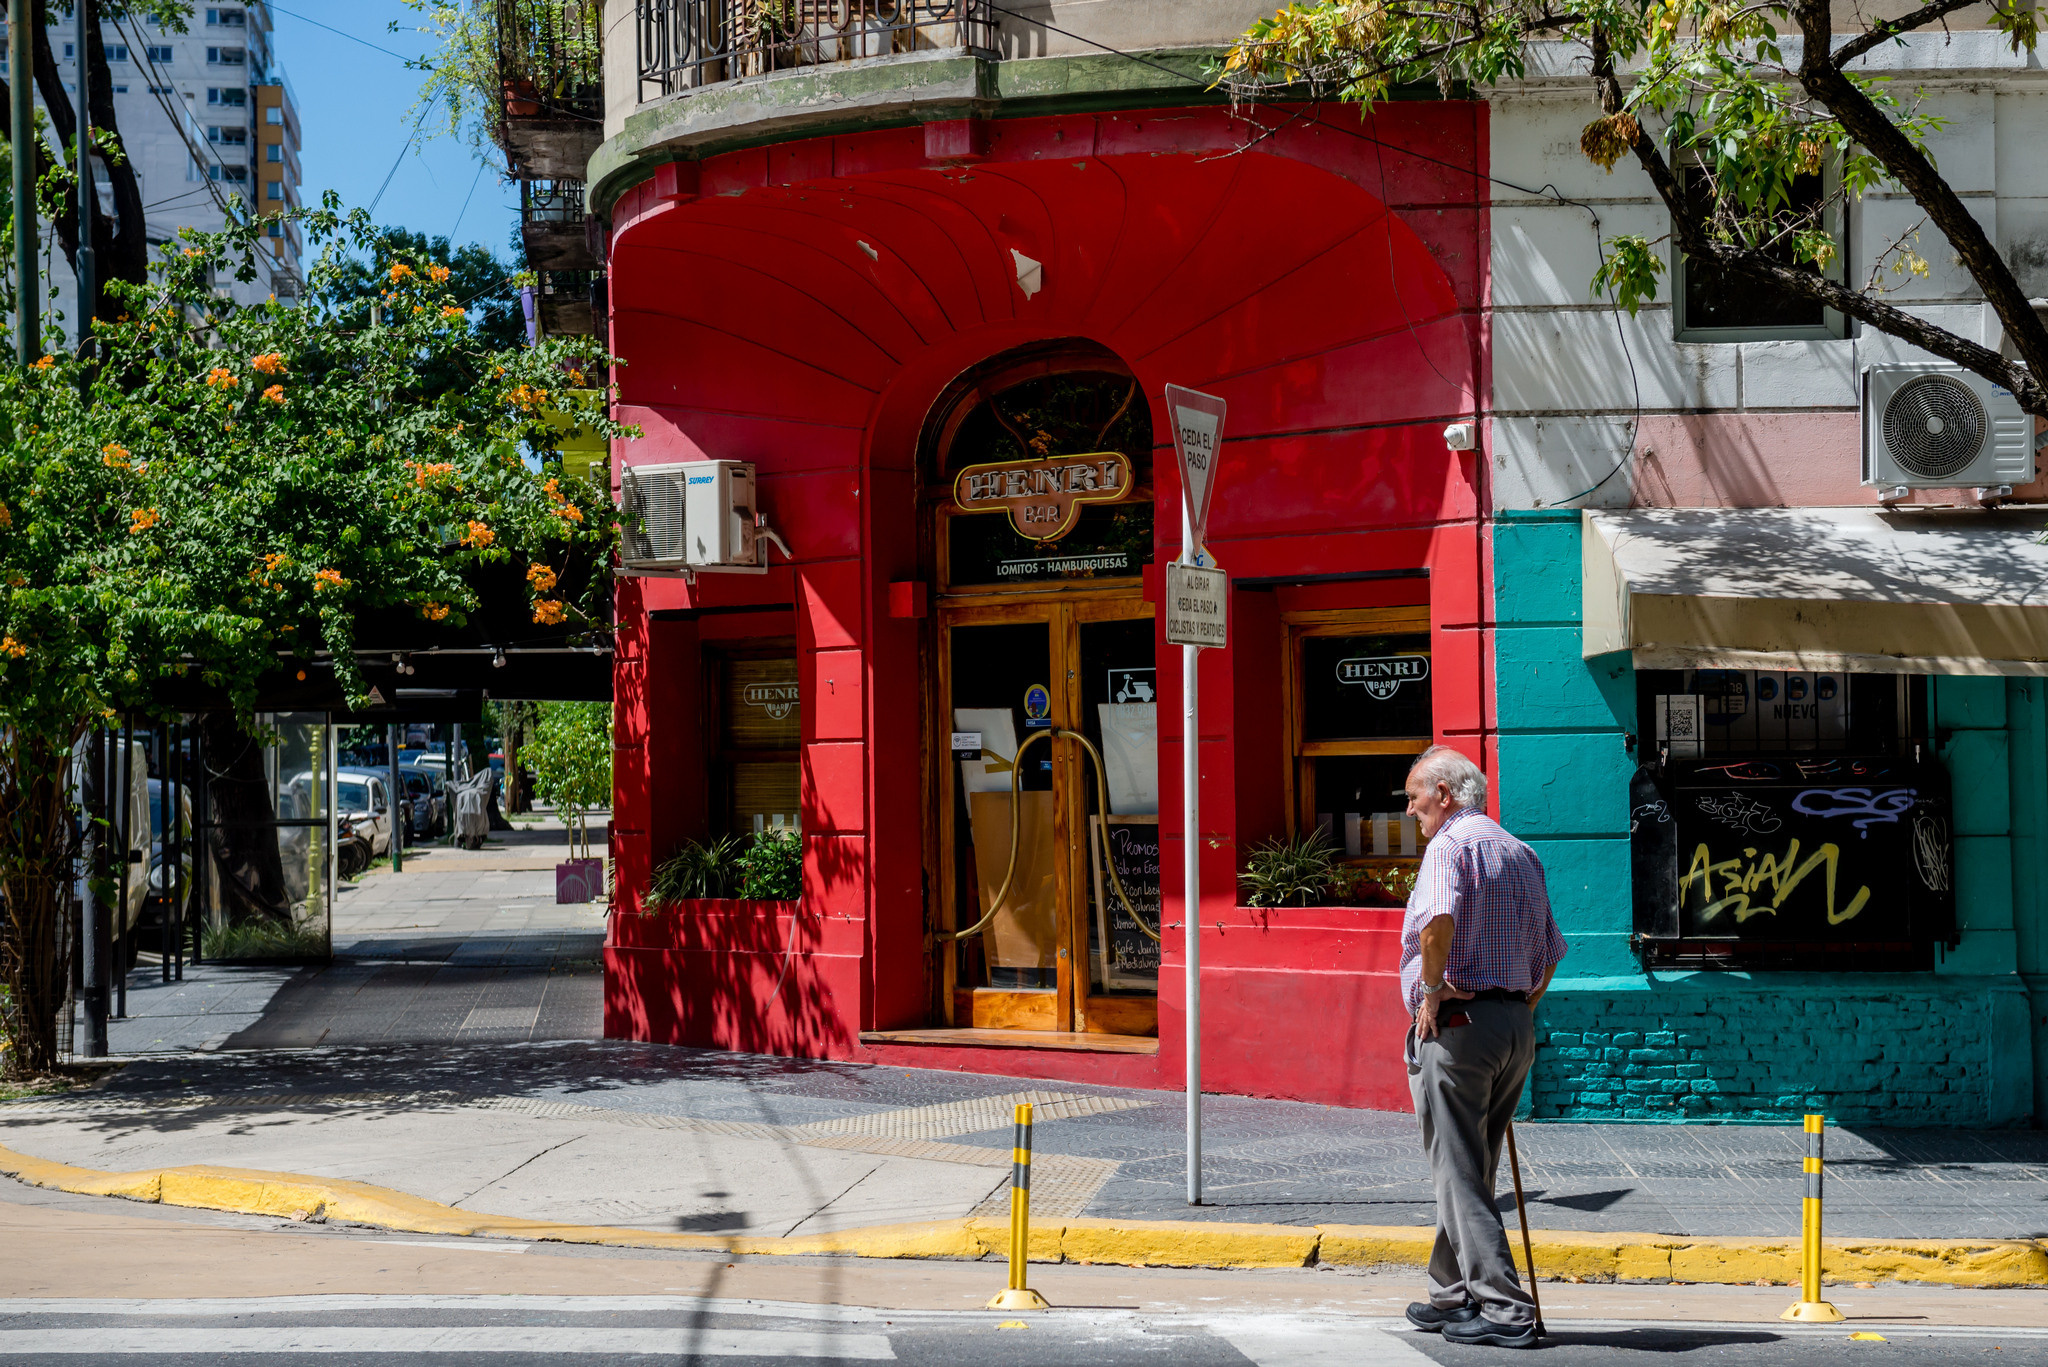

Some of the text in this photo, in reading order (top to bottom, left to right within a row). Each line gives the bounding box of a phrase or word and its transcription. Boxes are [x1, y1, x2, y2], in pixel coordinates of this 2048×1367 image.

[1181, 428, 1212, 450] CEDA EL
[1187, 451, 1207, 470] PASO
[688, 476, 715, 485] SURREY
[963, 459, 1122, 501] HENRI
[1023, 505, 1061, 523] BAR
[997, 563, 1038, 576] LOMITOS
[1047, 557, 1128, 573] HAMBURGUESAS
[1186, 575, 1210, 591] AL GIRAR
[1178, 597, 1193, 613] CEDA
[1193, 599, 1200, 613] EL
[1200, 599, 1213, 615] PASO
[1169, 619, 1225, 638] CICLISTAS Y PEATONES
[1344, 661, 1420, 678] HENRI
[1373, 681, 1391, 689] BAR
[750, 687, 799, 700] HENR
[771, 703, 785, 711] BAR
[1773, 703, 1818, 720] NUEVO
[1131, 866, 1142, 875] en
[1107, 897, 1116, 911] 2
[1113, 914, 1137, 930] Jamón
[1115, 938, 1135, 954] Café
